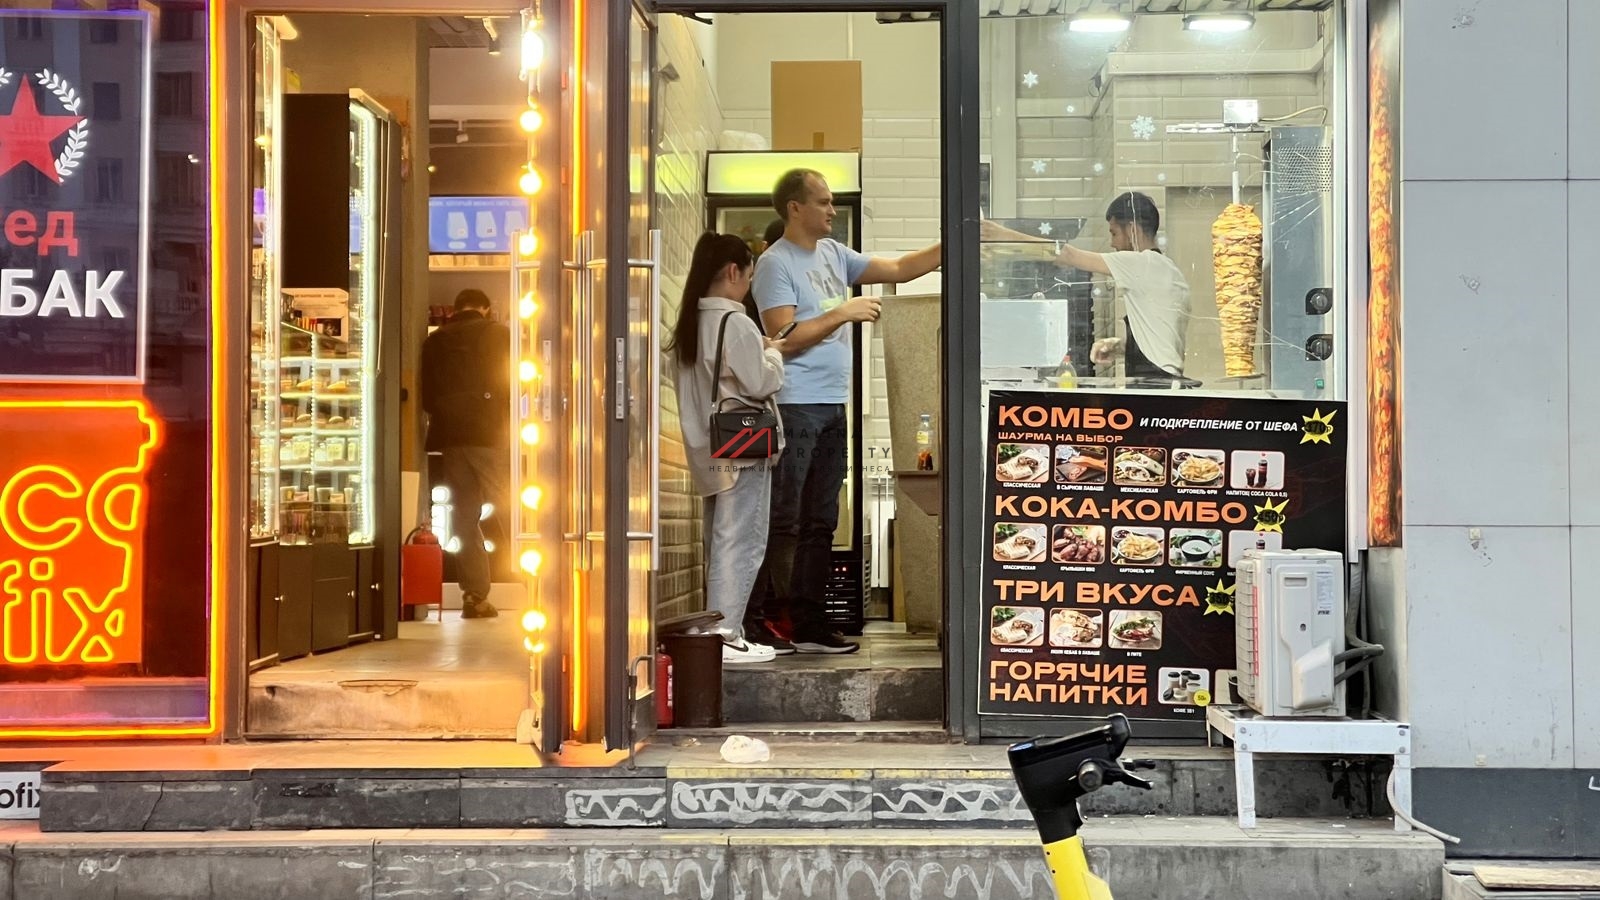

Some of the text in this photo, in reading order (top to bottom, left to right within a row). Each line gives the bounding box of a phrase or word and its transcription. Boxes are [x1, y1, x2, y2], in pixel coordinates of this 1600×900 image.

[0, 210, 78, 257] ед
[998, 405, 1134, 430] КОМБО
[1139, 417, 1298, 431] И ПОДКРЕПЛЕНИЕ ОТ ШЕФА
[997, 431, 1124, 443] ШАУРМА НА ВЫБОР
[995, 495, 1248, 524] КОКА-КОМБО
[993, 579, 1200, 607] ТРИ ВКУСА
[990, 660, 1147, 684] ГОРЯЧИЕ
[990, 682, 1148, 706] НАПИТКИ
